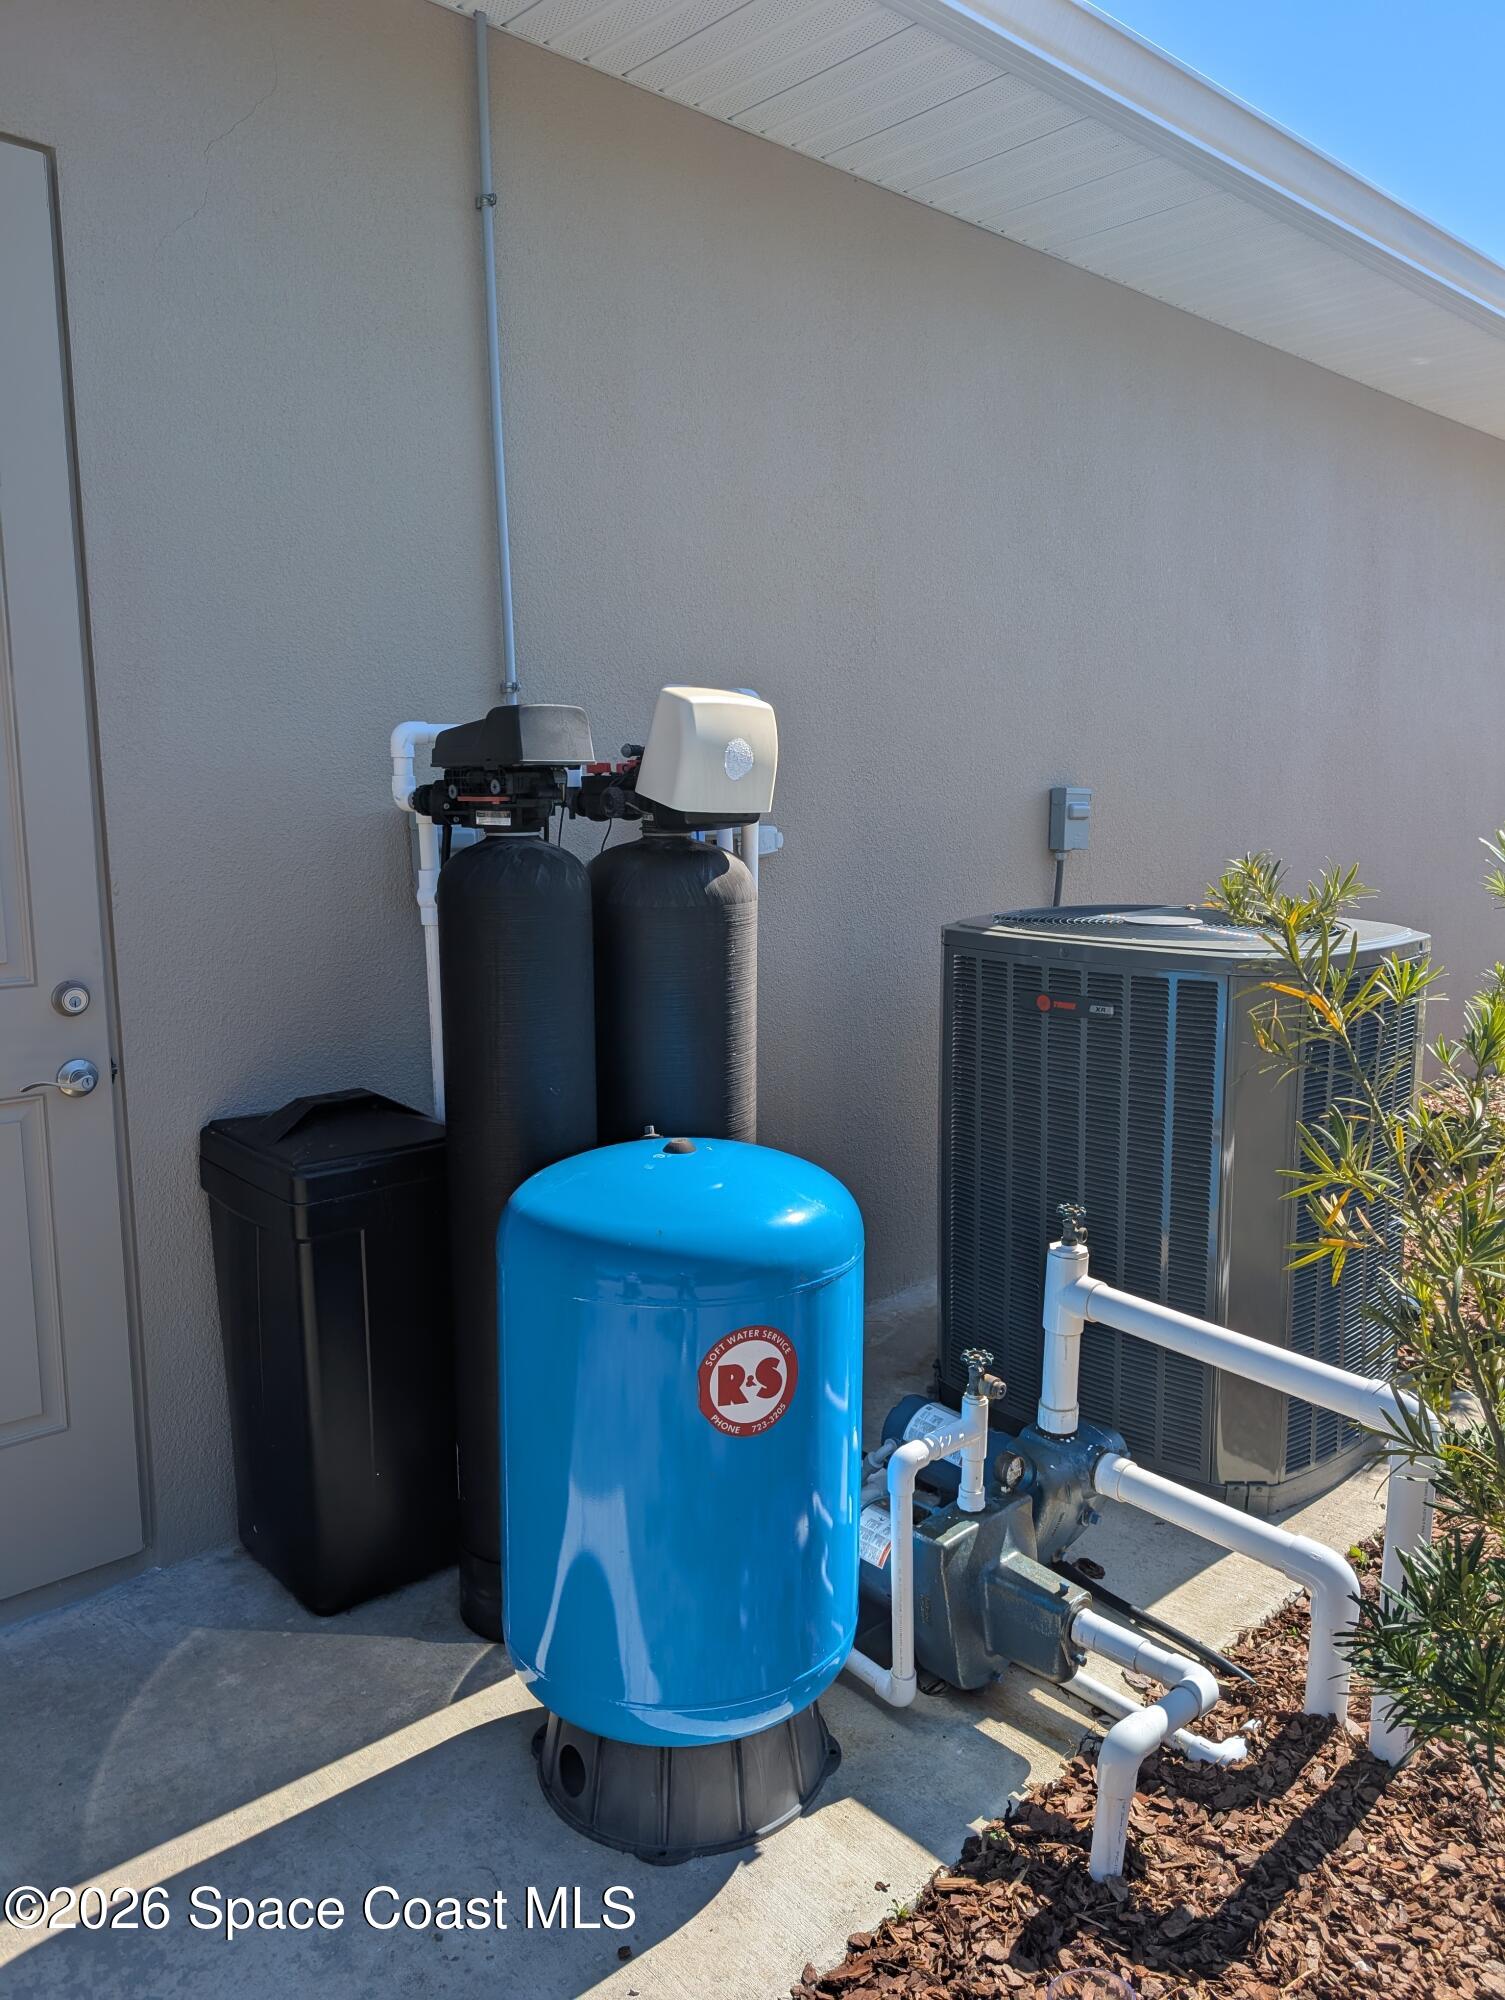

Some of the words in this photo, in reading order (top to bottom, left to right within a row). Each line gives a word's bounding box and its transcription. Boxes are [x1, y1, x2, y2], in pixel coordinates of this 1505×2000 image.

[705, 1343, 726, 1367] SOFT
[726, 1329, 760, 1345] WATER
[762, 1330, 792, 1355] SERVICE
[710, 1414, 741, 1434] PHONE
[751, 1402, 787, 1433] 723-3205
